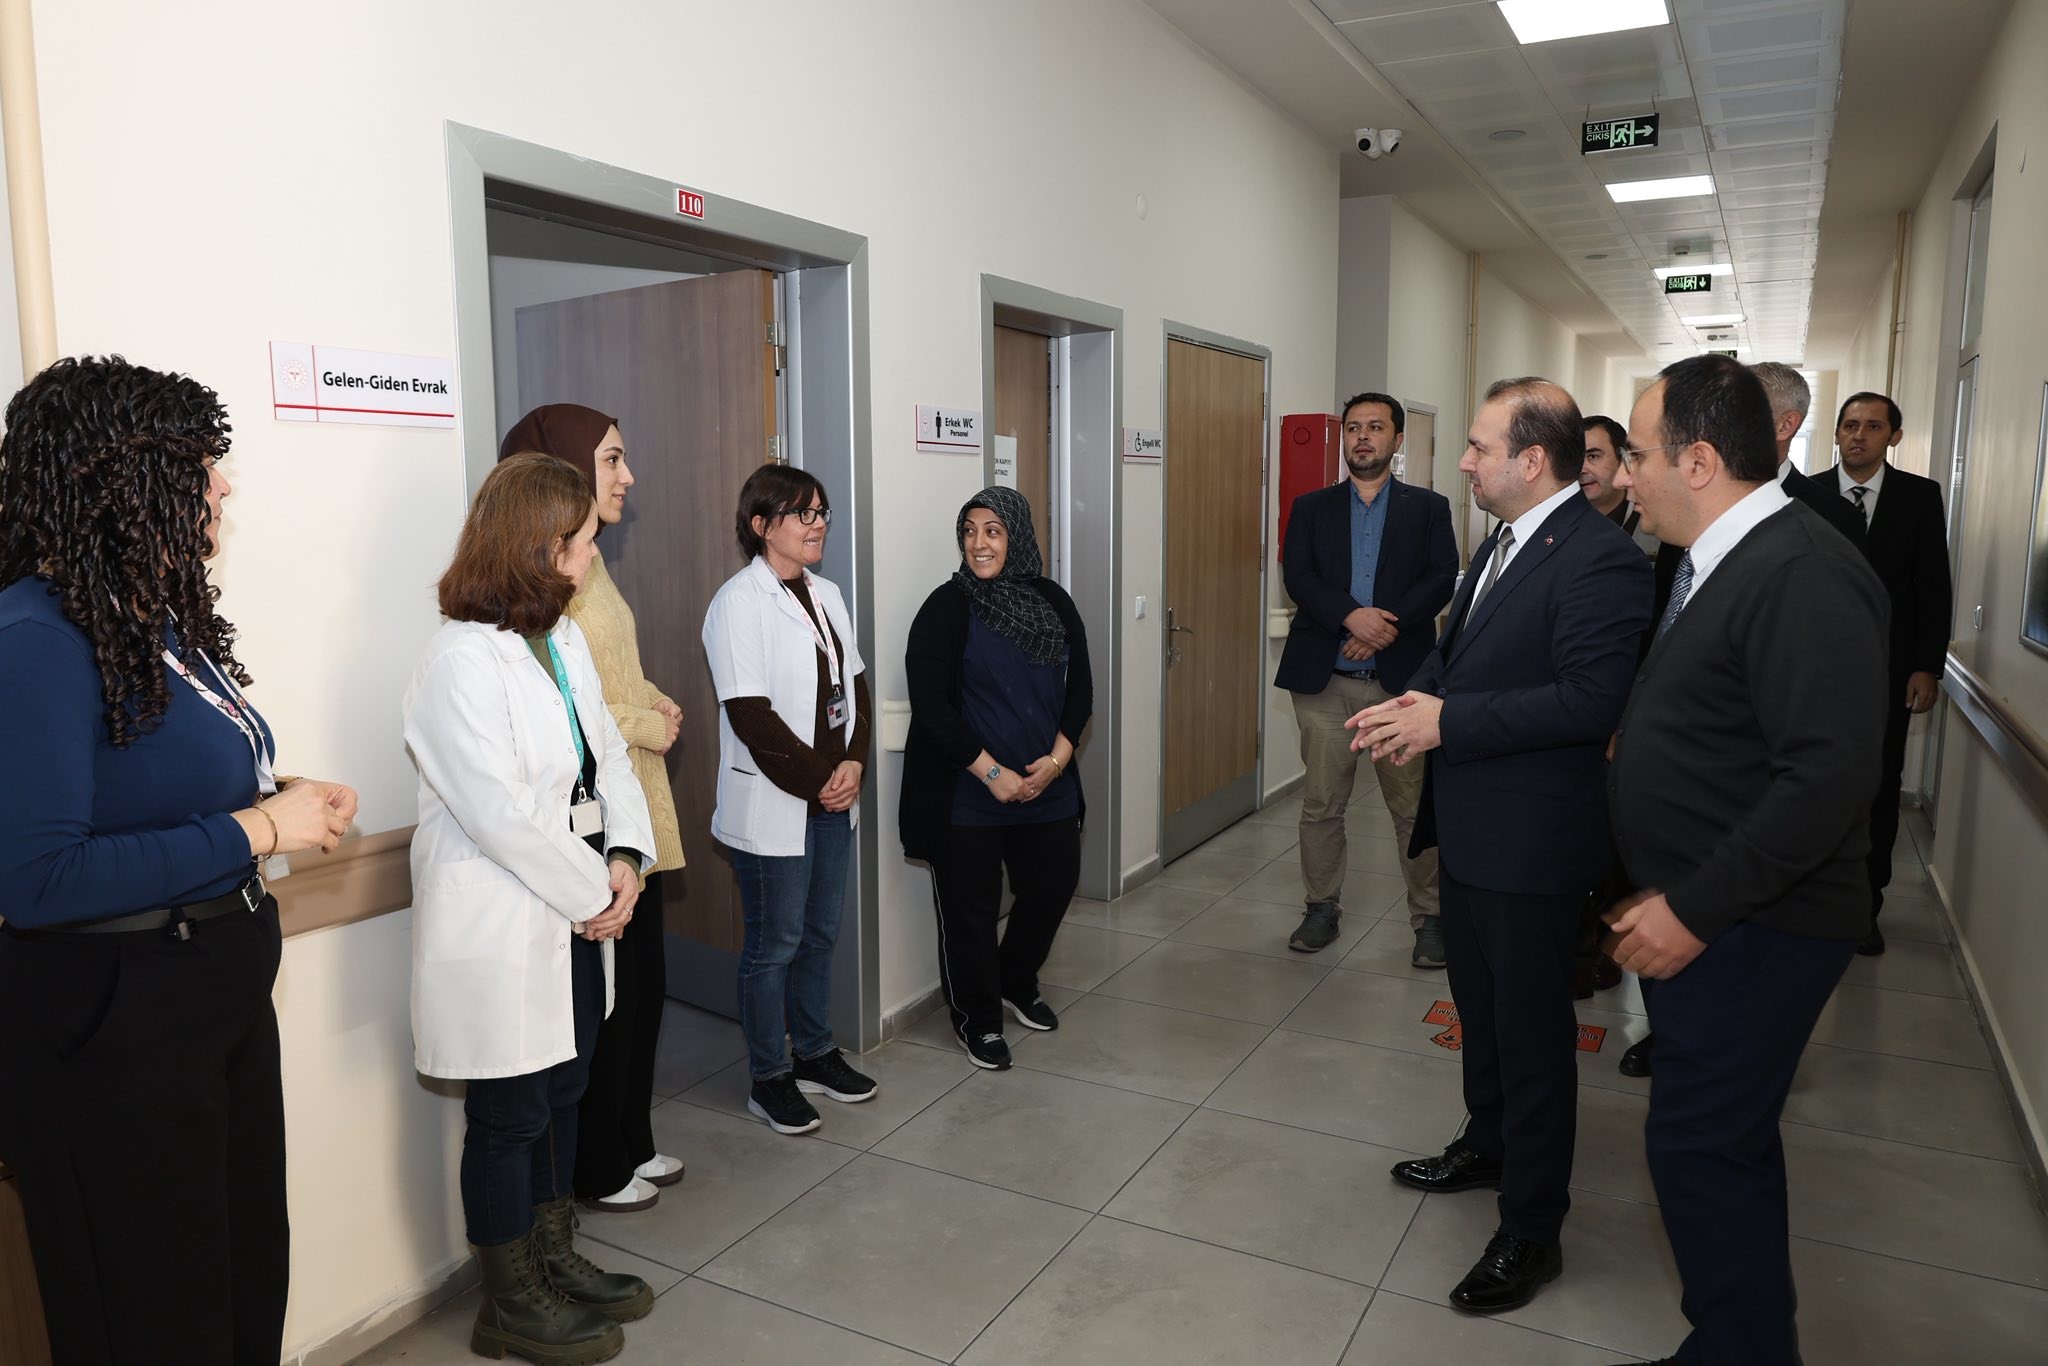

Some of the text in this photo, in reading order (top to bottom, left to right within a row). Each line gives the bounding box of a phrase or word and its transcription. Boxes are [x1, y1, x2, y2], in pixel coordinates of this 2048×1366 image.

[1586, 123, 1610, 133] EXIT
[681, 194, 702, 215] 110
[322, 371, 448, 394] Gelen-Giden Evrak
[945, 417, 974, 429] Erkek WC
[950, 429, 969, 437] Personel
